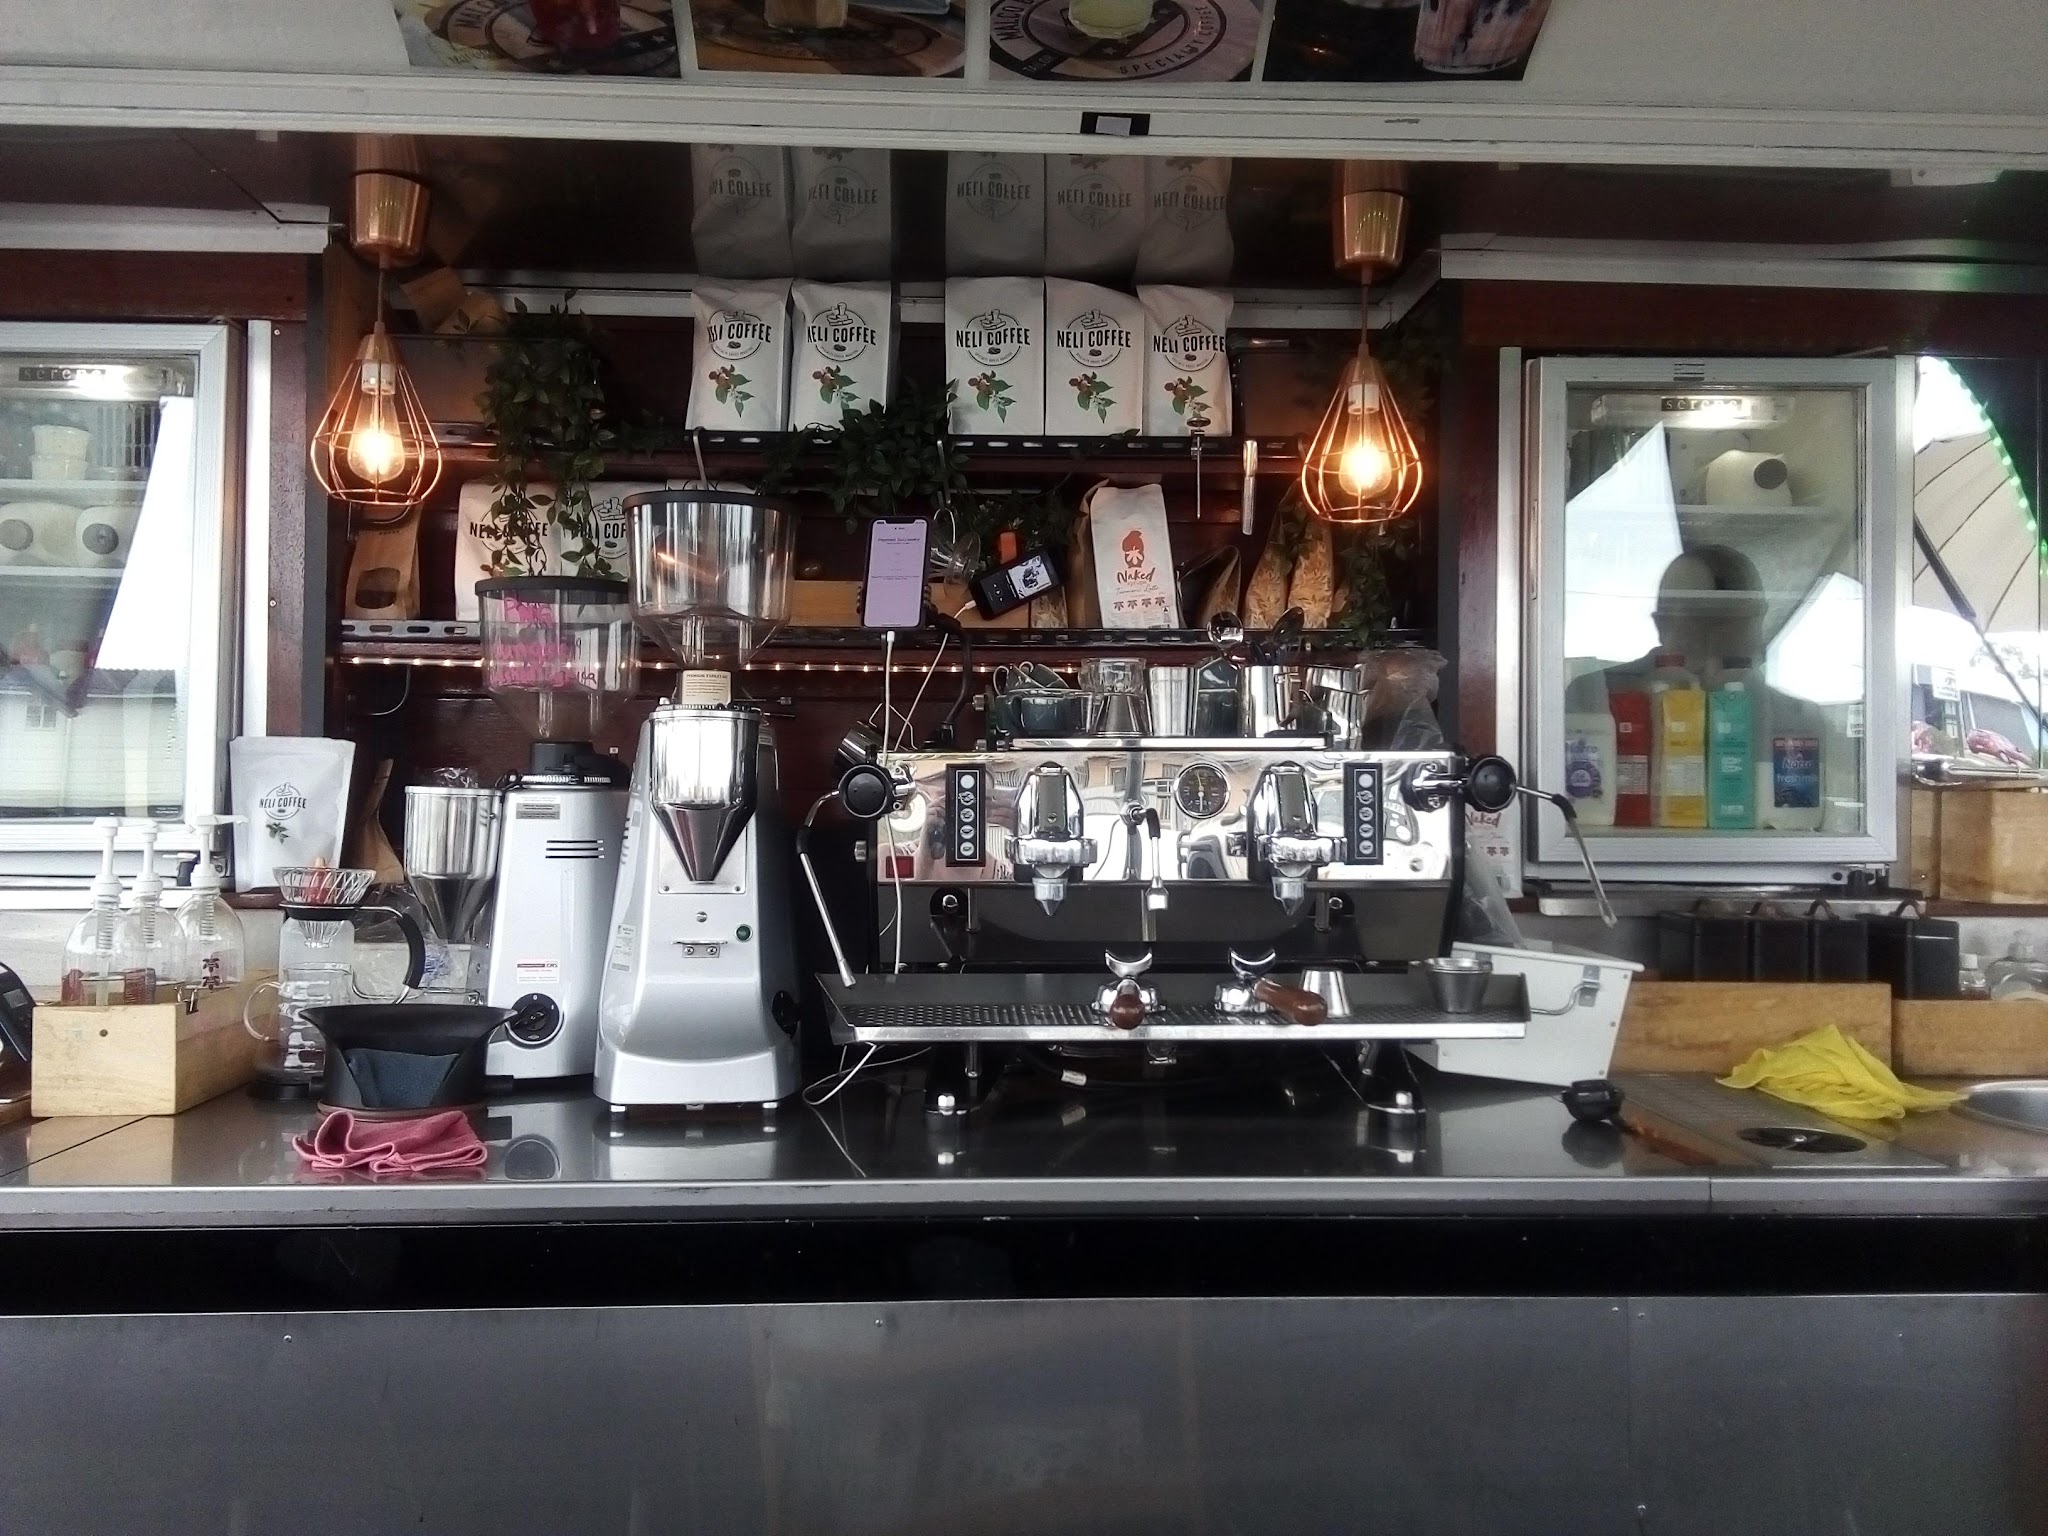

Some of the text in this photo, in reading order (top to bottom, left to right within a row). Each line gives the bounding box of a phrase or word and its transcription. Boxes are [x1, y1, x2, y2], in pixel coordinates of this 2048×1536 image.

[993, 6, 1025, 41] MALCO
[1119, 39, 1205, 75] SPECIALTY
[727, 322, 772, 344] COFFEE
[807, 325, 877, 346] NELI COFFEE
[956, 327, 1031, 348] NELI COFFEE
[1057, 329, 1132, 349] NELI COFFEE
[1153, 335, 1225, 354] NELI COFFEE
[1117, 567, 1156, 584] Naked
[259, 796, 307, 809] NELI COFFEE
